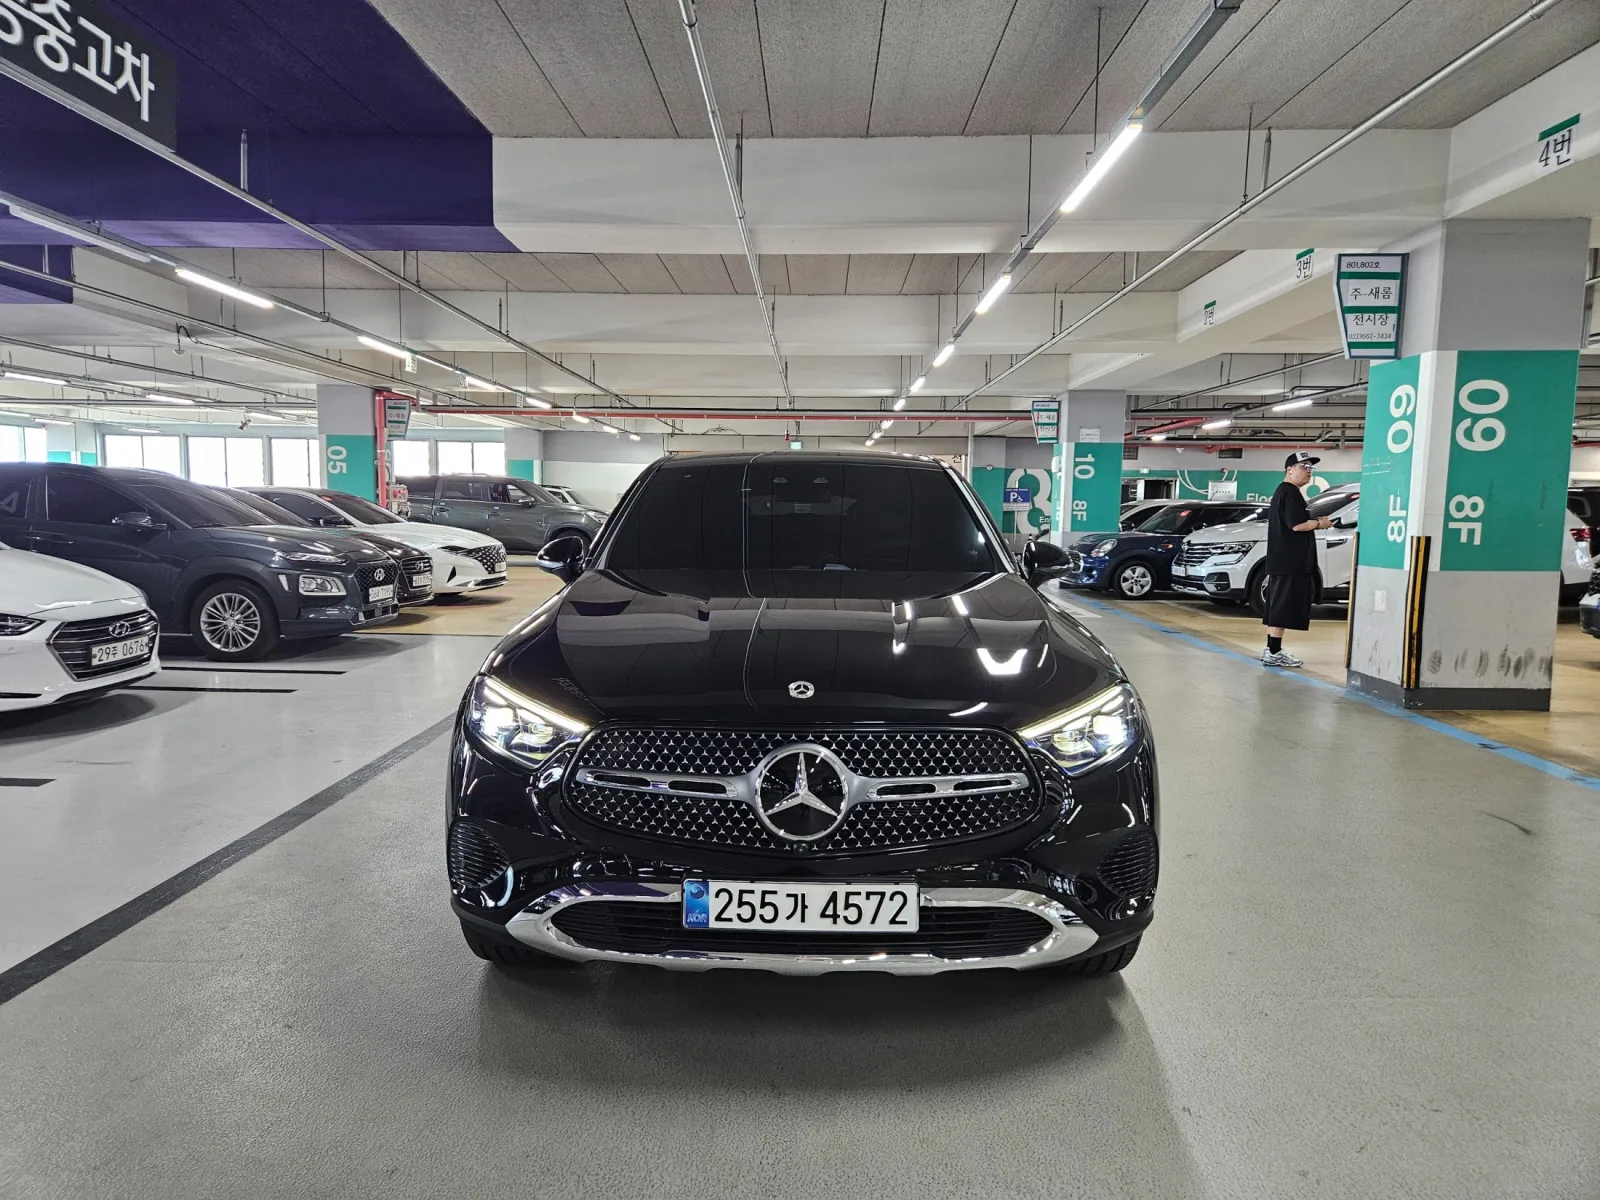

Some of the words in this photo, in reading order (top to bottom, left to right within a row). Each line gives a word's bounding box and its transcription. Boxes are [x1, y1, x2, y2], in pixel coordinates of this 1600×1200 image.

[1538, 128, 1572, 168] 4번
[1296, 256, 1312, 280] 3번
[1352, 313, 1390, 326] 전시장
[1387, 384, 1417, 453] 09
[1455, 379, 1509, 452] 09
[327, 445, 348, 474] 05
[1074, 453, 1095, 480] 10
[1009, 491, 1019, 503] P
[1072, 500, 1088, 521] 8F
[1387, 494, 1408, 543] 8F
[1448, 494, 1485, 545] 8F
[97, 646, 118, 663] 29주
[122, 640, 145, 657] 0676
[714, 888, 808, 924] 255가
[819, 890, 908, 925] 4572
